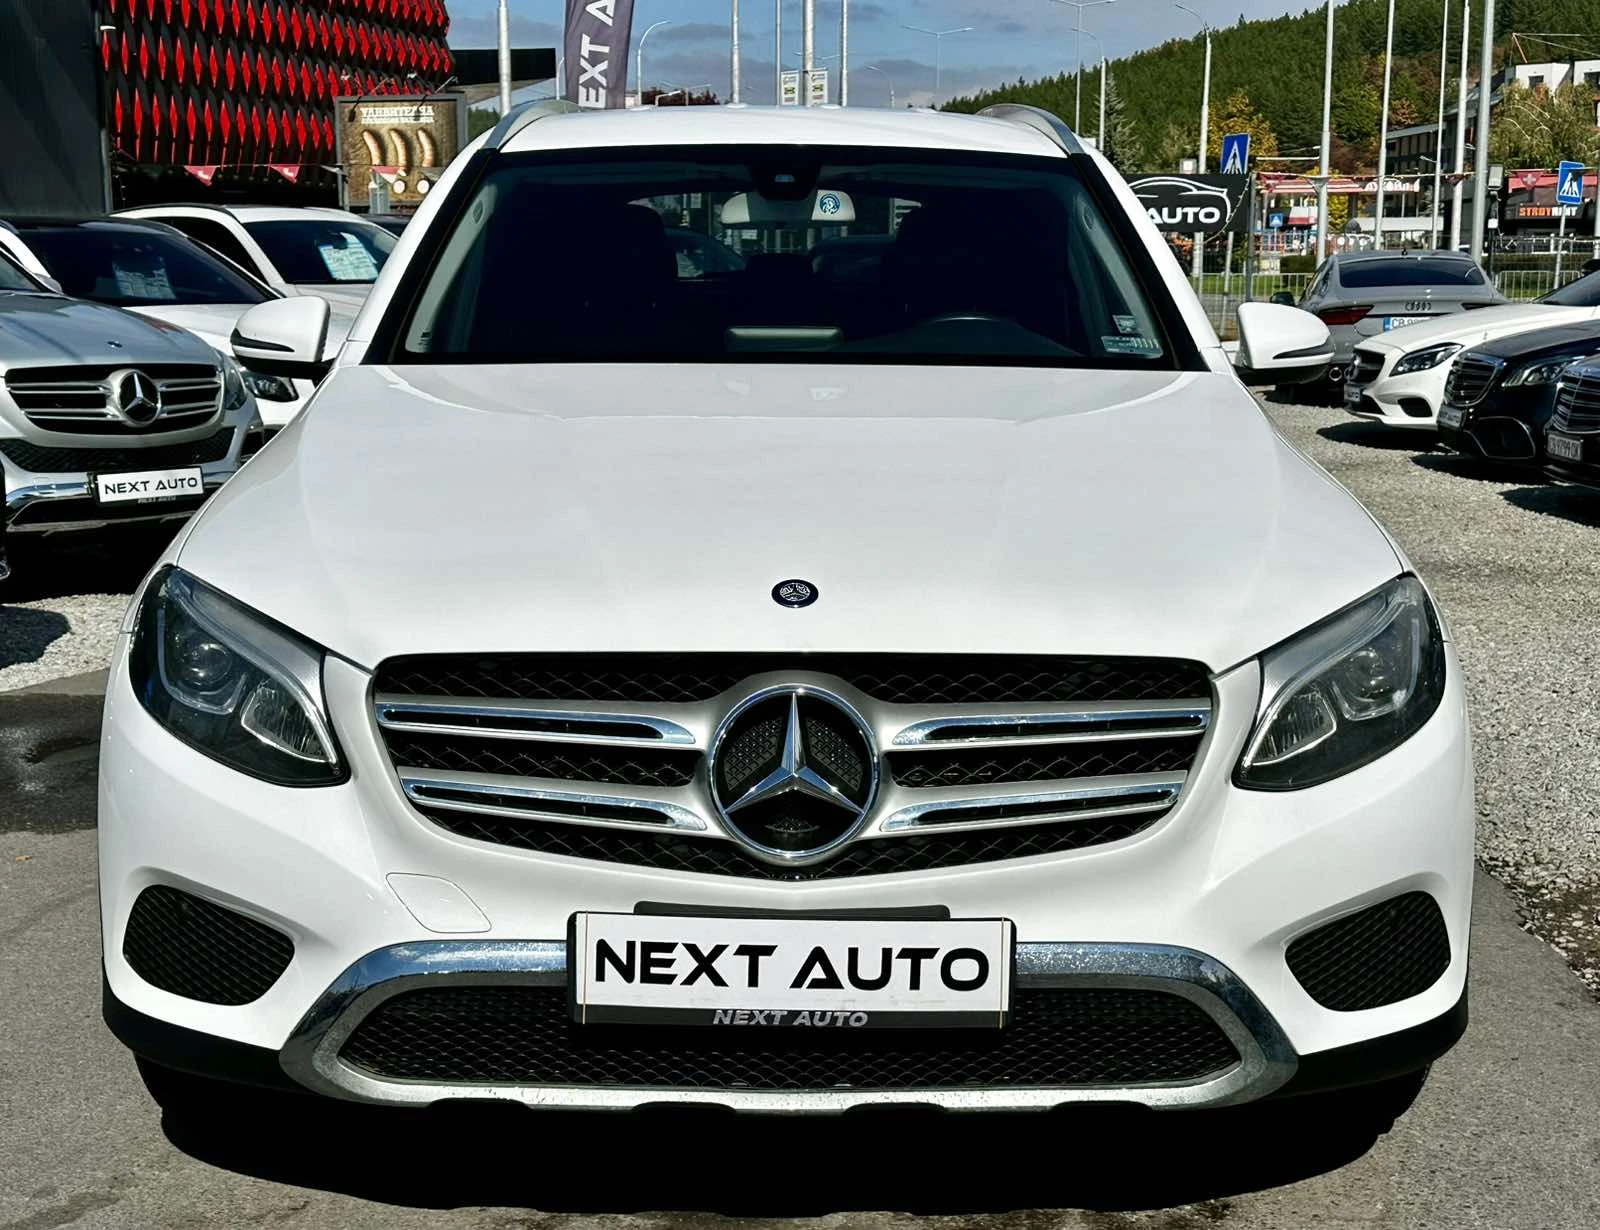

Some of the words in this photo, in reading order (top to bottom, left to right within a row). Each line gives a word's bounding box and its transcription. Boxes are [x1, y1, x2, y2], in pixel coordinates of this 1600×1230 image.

[1147, 206, 1220, 224] AUTO
[104, 480, 150, 495] NEXT
[155, 477, 198, 491] AUTO
[595, 937, 778, 988] NEXT
[788, 945, 990, 992] AUTO
[712, 1009, 788, 1027] NEXT
[792, 1010, 869, 1027] AUTO
